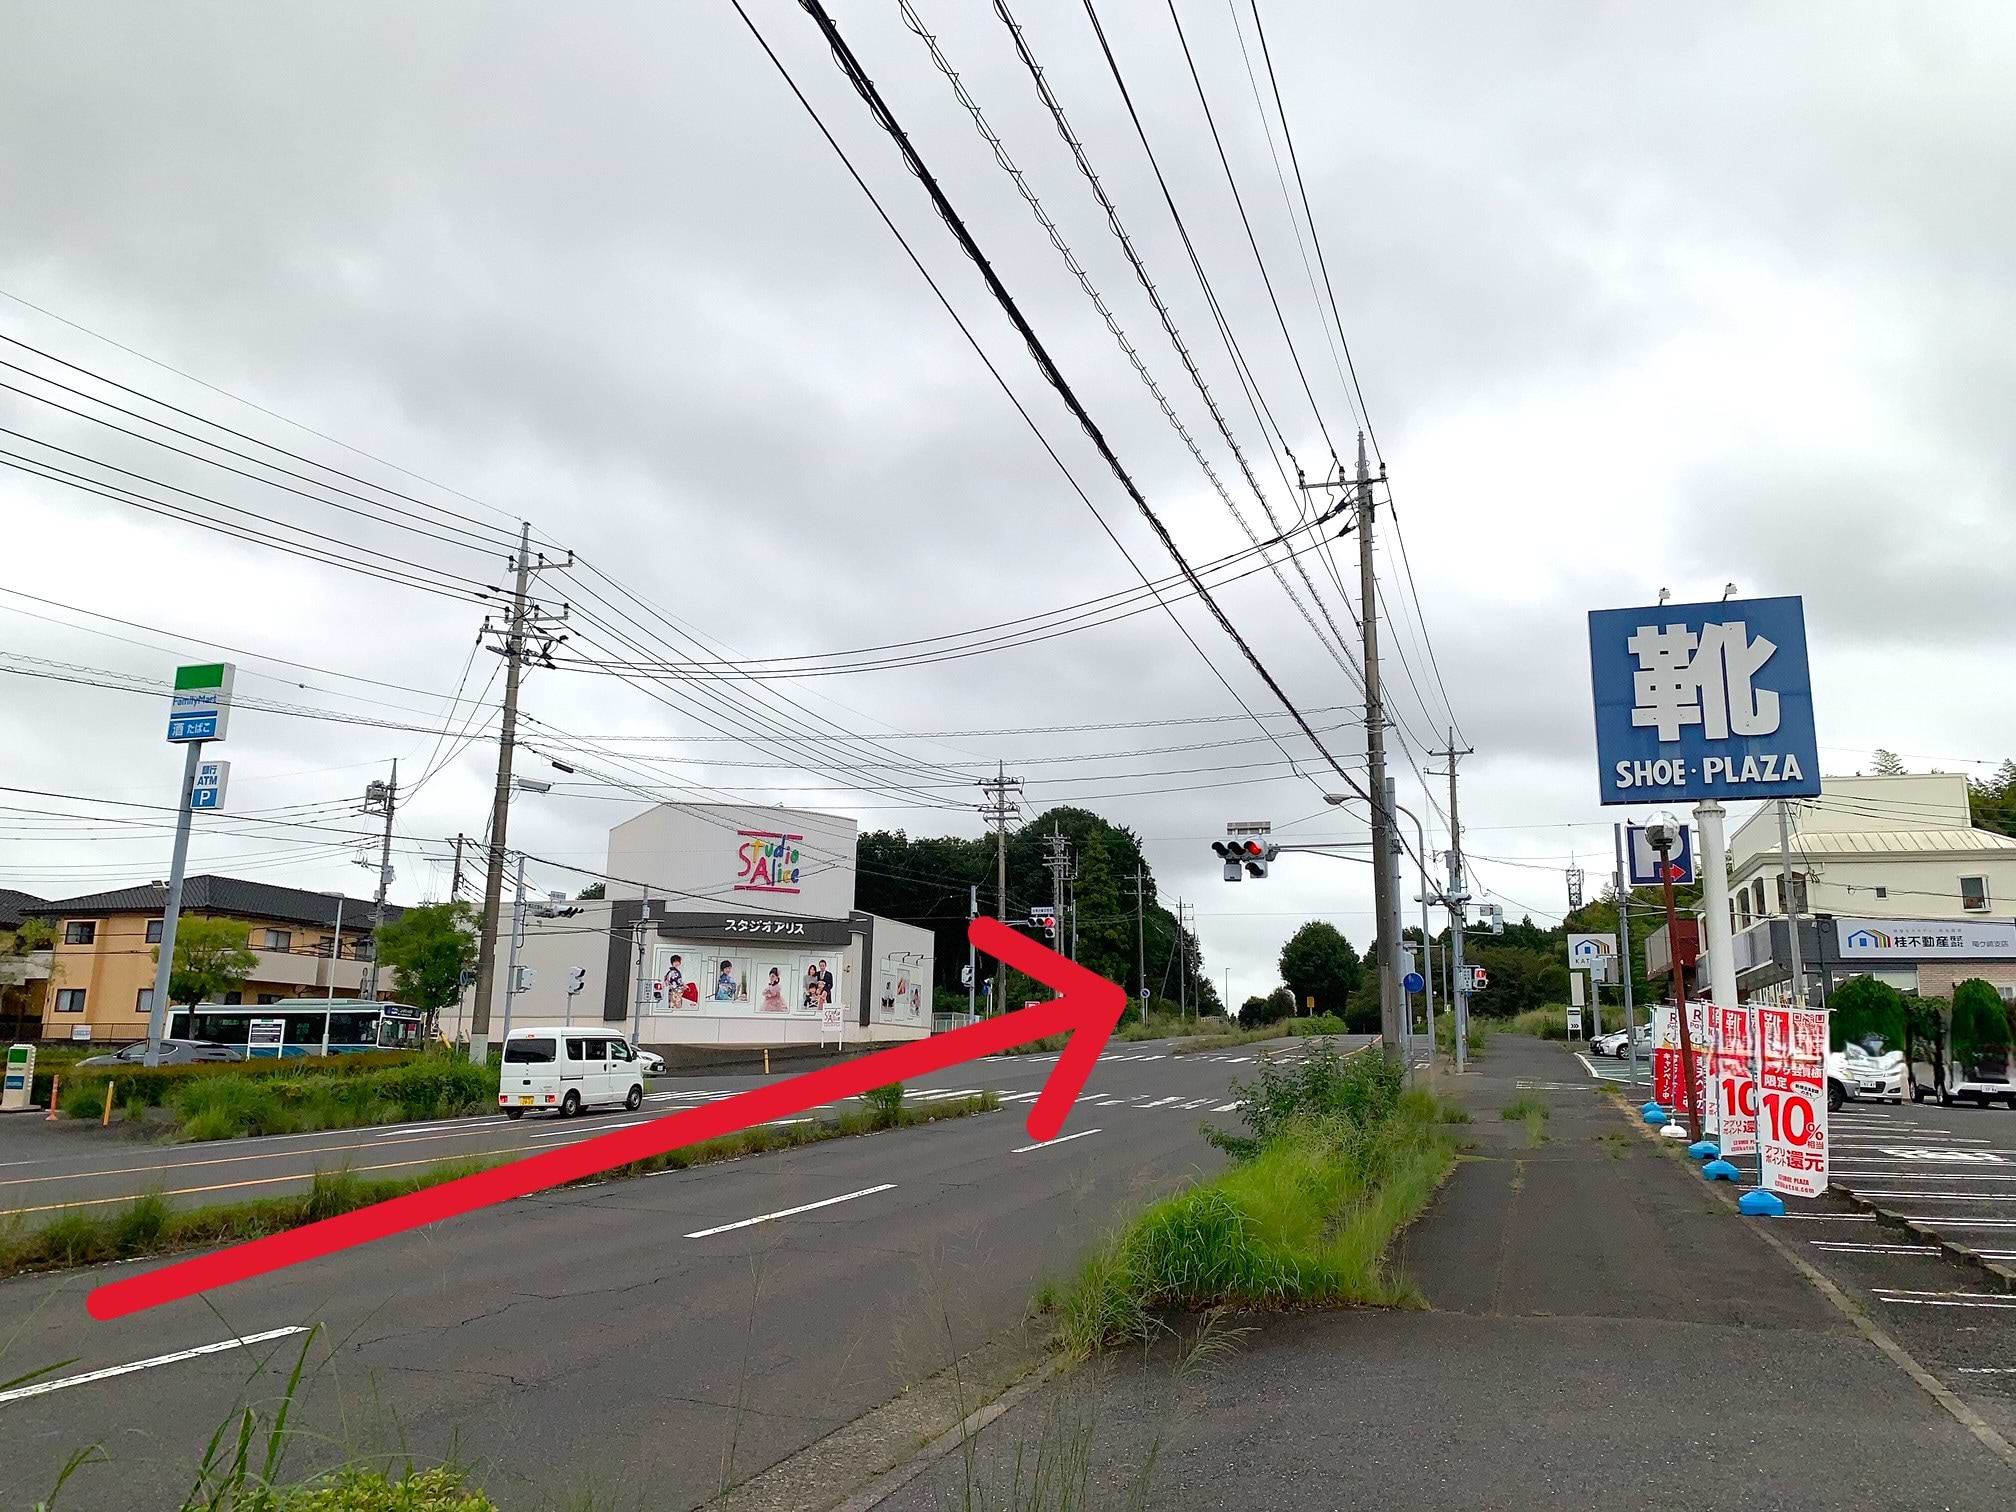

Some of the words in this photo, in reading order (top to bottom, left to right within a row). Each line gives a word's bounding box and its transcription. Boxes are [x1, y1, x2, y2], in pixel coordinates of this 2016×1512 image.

[1627, 621, 1781, 742] 靴
[172, 723, 184, 736] 酒
[187, 722, 211, 734] たばこ
[1616, 759, 1686, 788] SHOE
[1703, 754, 1803, 784] PLAZA
[197, 775, 217, 786] ATM
[199, 790, 211, 806] P
[725, 920, 805, 935] スタジオアリス
[1693, 1010, 1702, 1021] R
[1764, 1074, 1788, 1089] 限定
[1765, 1145, 1786, 1157] アプリ
[1786, 1150, 1825, 1173] 還元
[1766, 1155, 1787, 1167] ポイント
